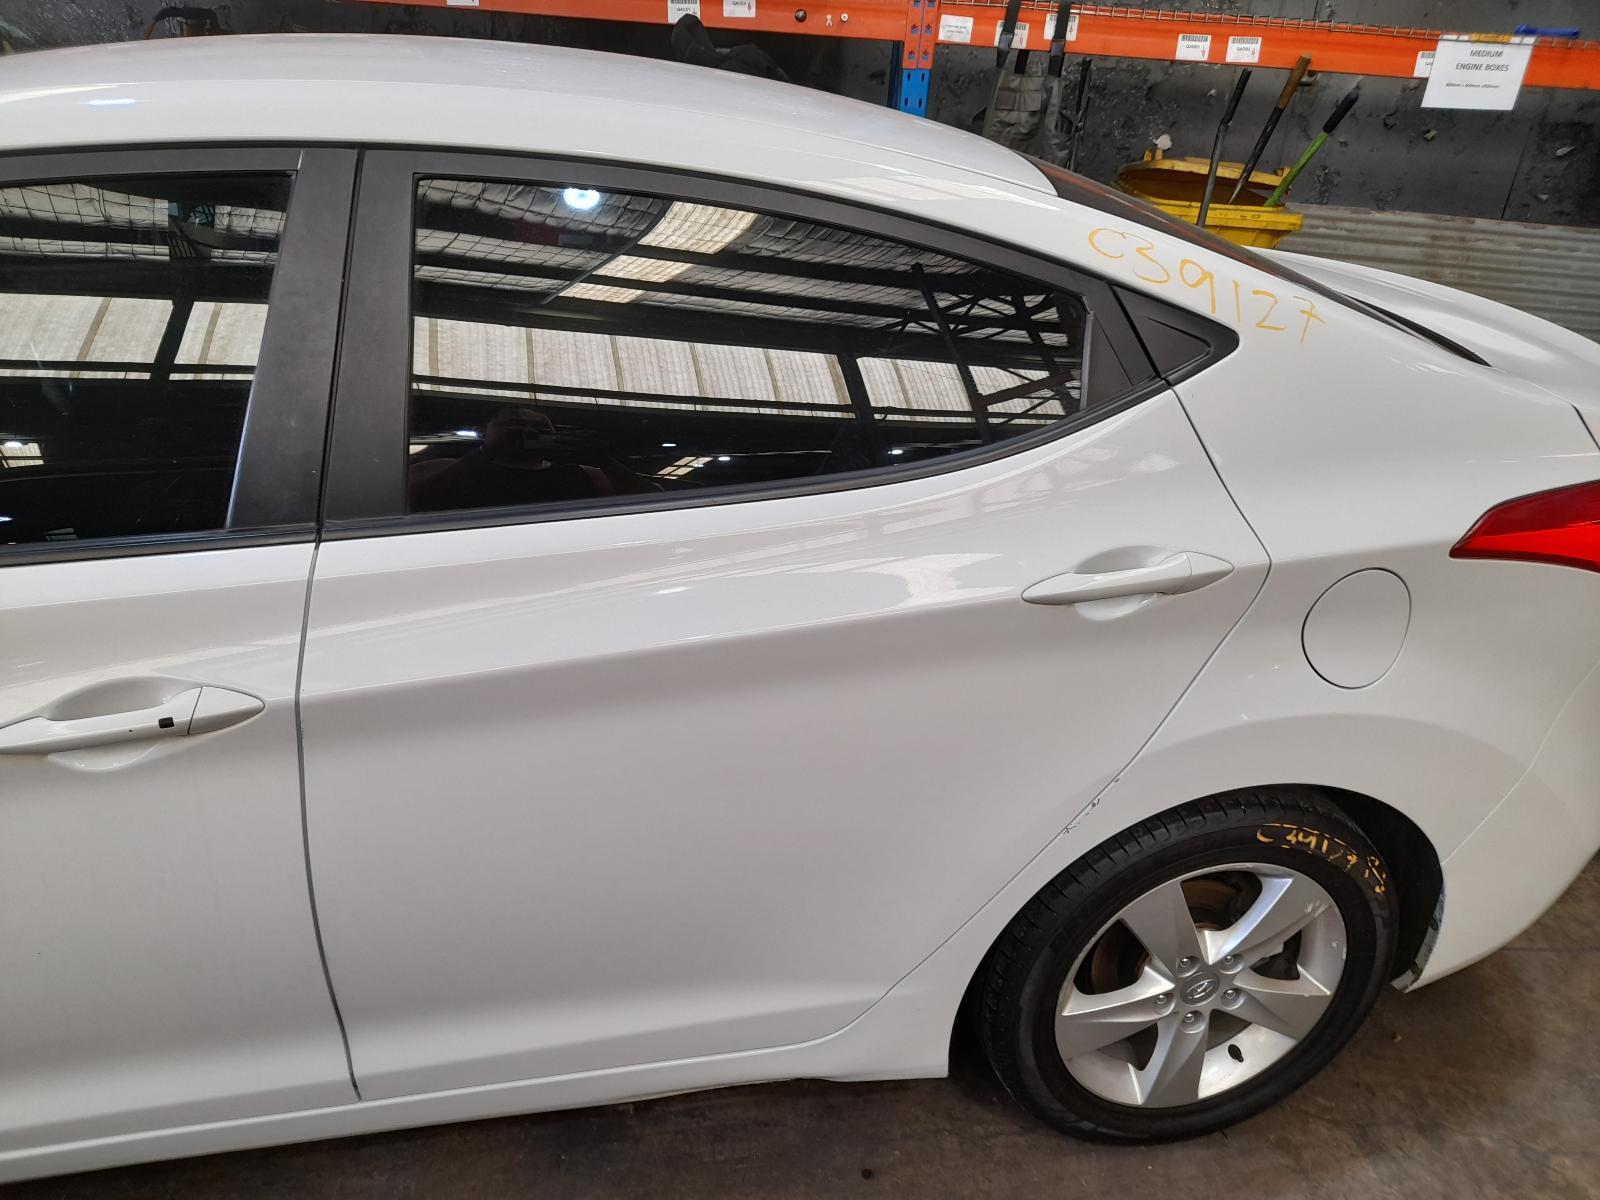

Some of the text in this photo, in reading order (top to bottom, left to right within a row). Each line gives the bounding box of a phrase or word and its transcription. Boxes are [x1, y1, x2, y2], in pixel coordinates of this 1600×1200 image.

[1469, 49, 1504, 58] MEDIUM
[1455, 62, 1510, 72] ENGINE BOXES
[1088, 227, 1327, 344] C39127
